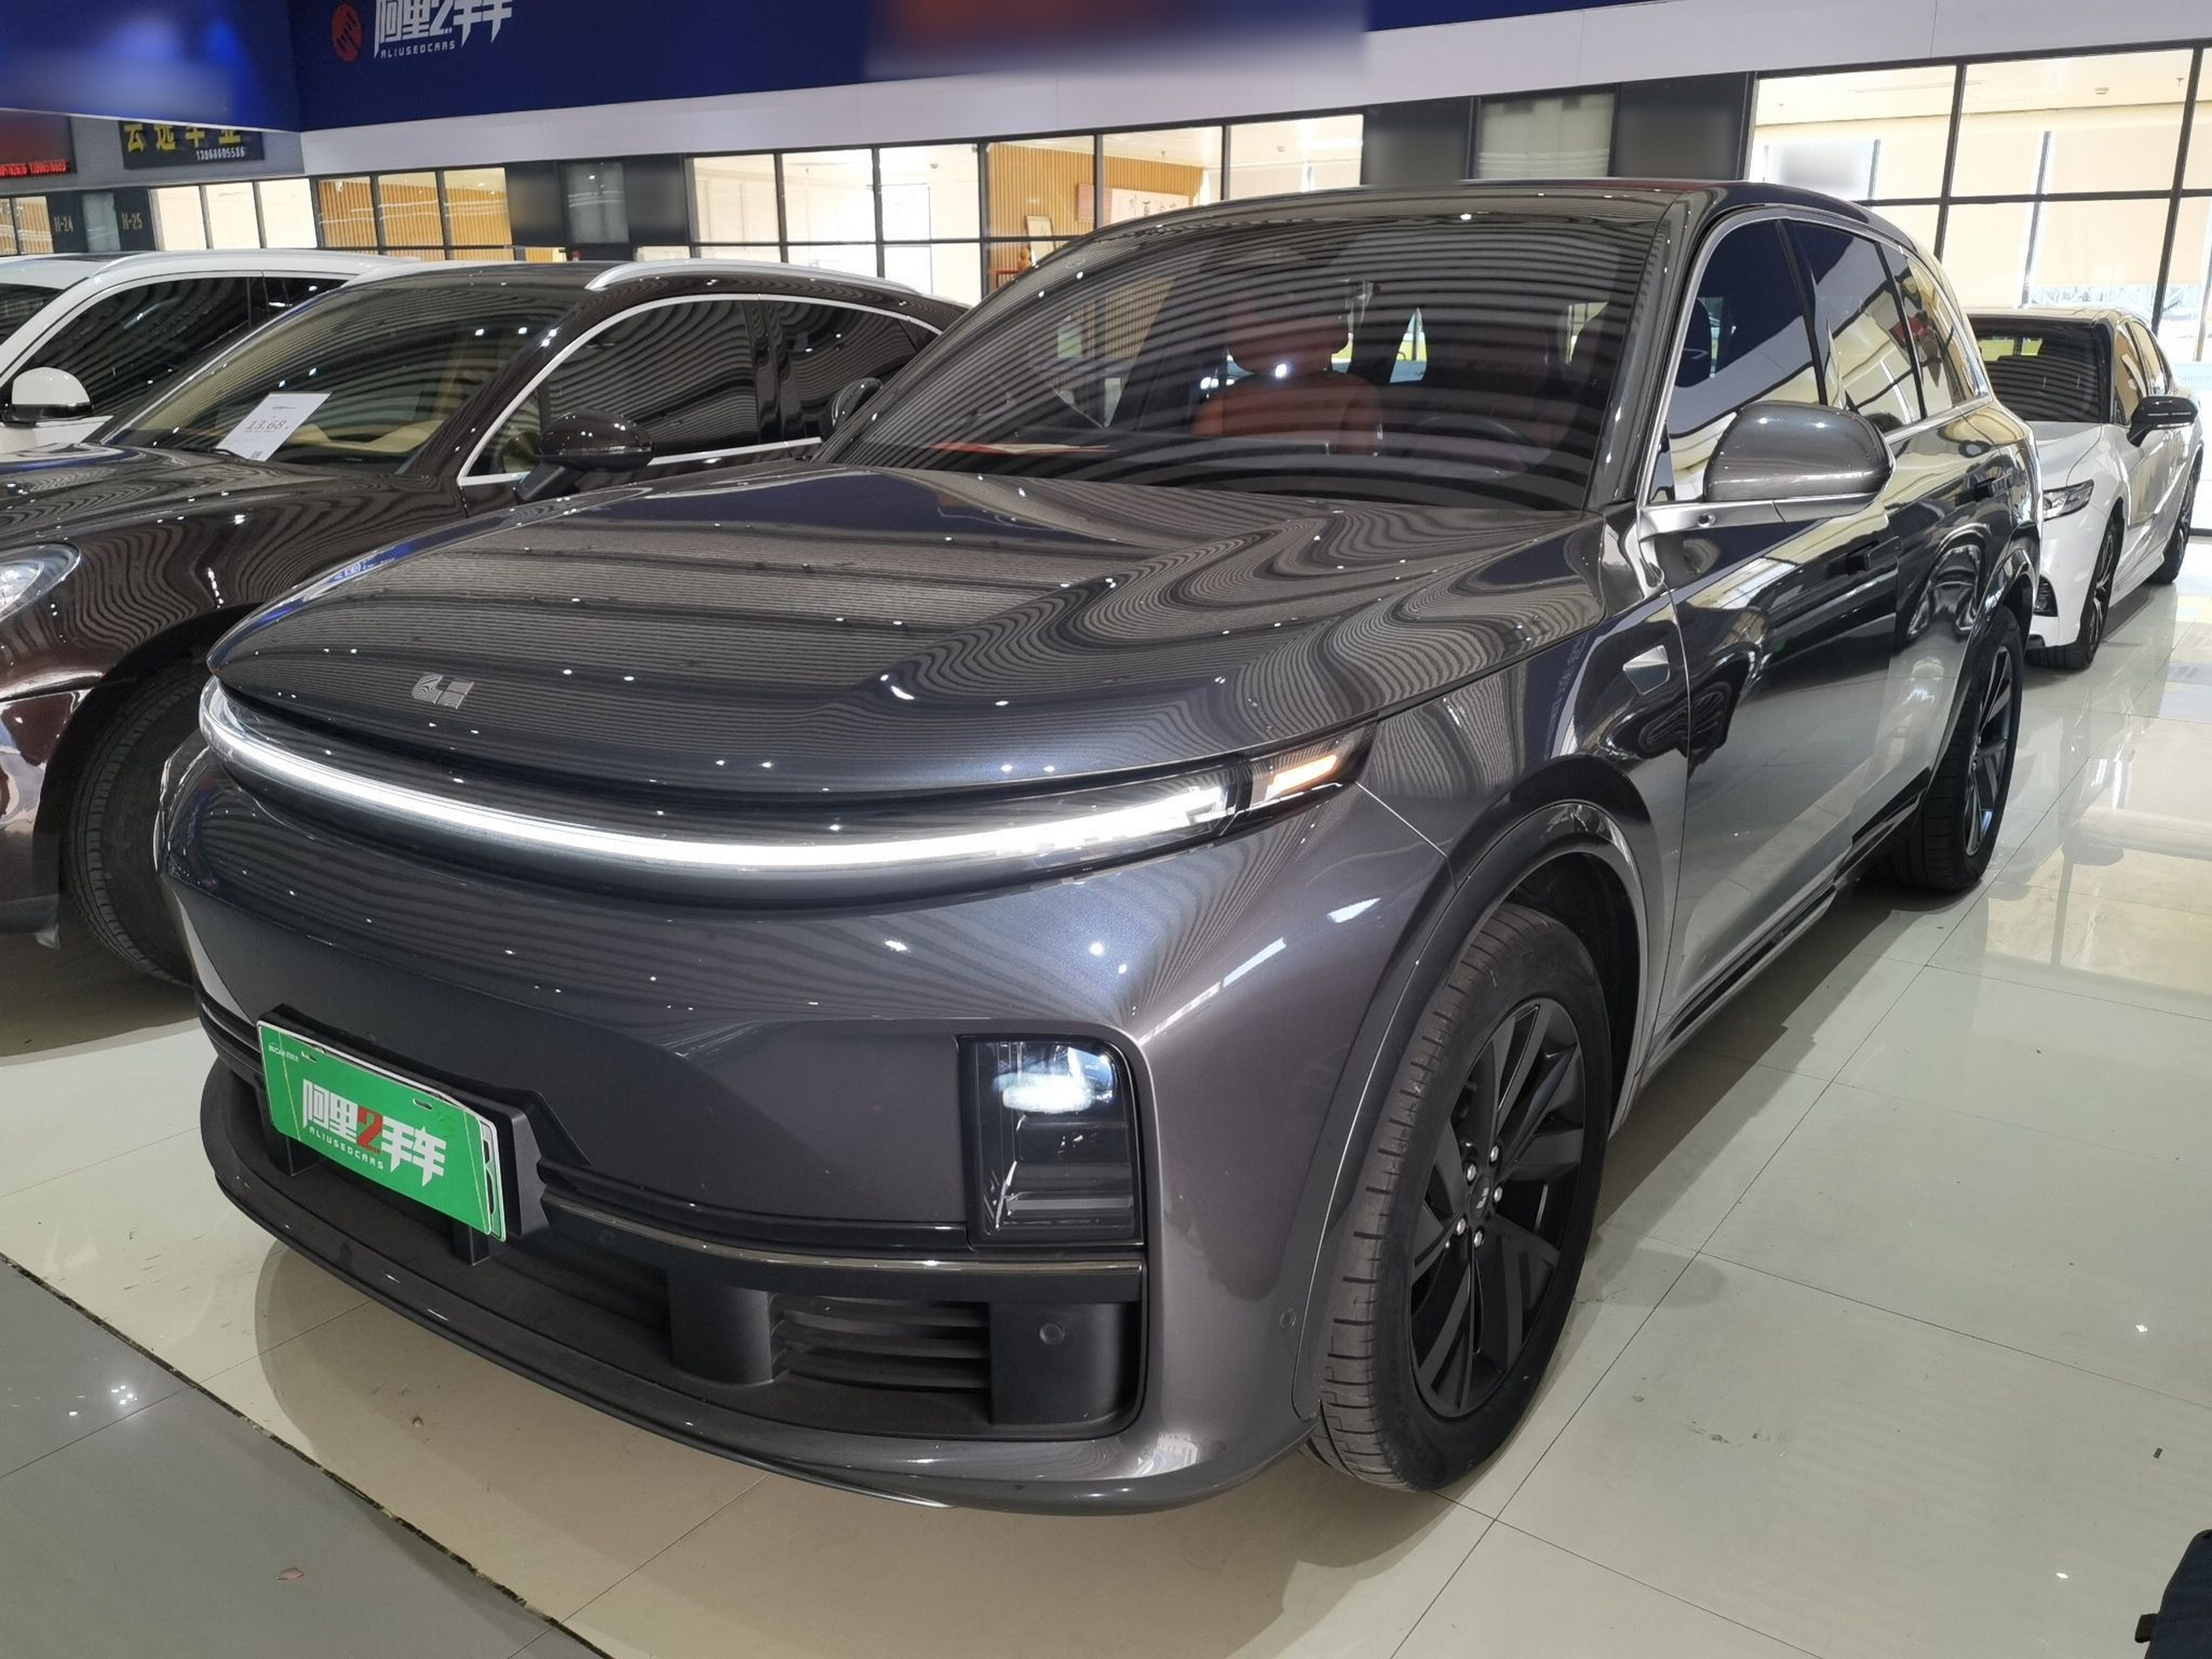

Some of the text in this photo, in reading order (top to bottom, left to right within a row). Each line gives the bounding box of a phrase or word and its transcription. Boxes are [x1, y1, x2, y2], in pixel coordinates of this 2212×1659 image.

[380, 40, 456, 58] ALIUSEDCARS
[302, 1078, 446, 1187] 阿里2手车
[309, 1125, 384, 1170] ALIUSEDCARS
